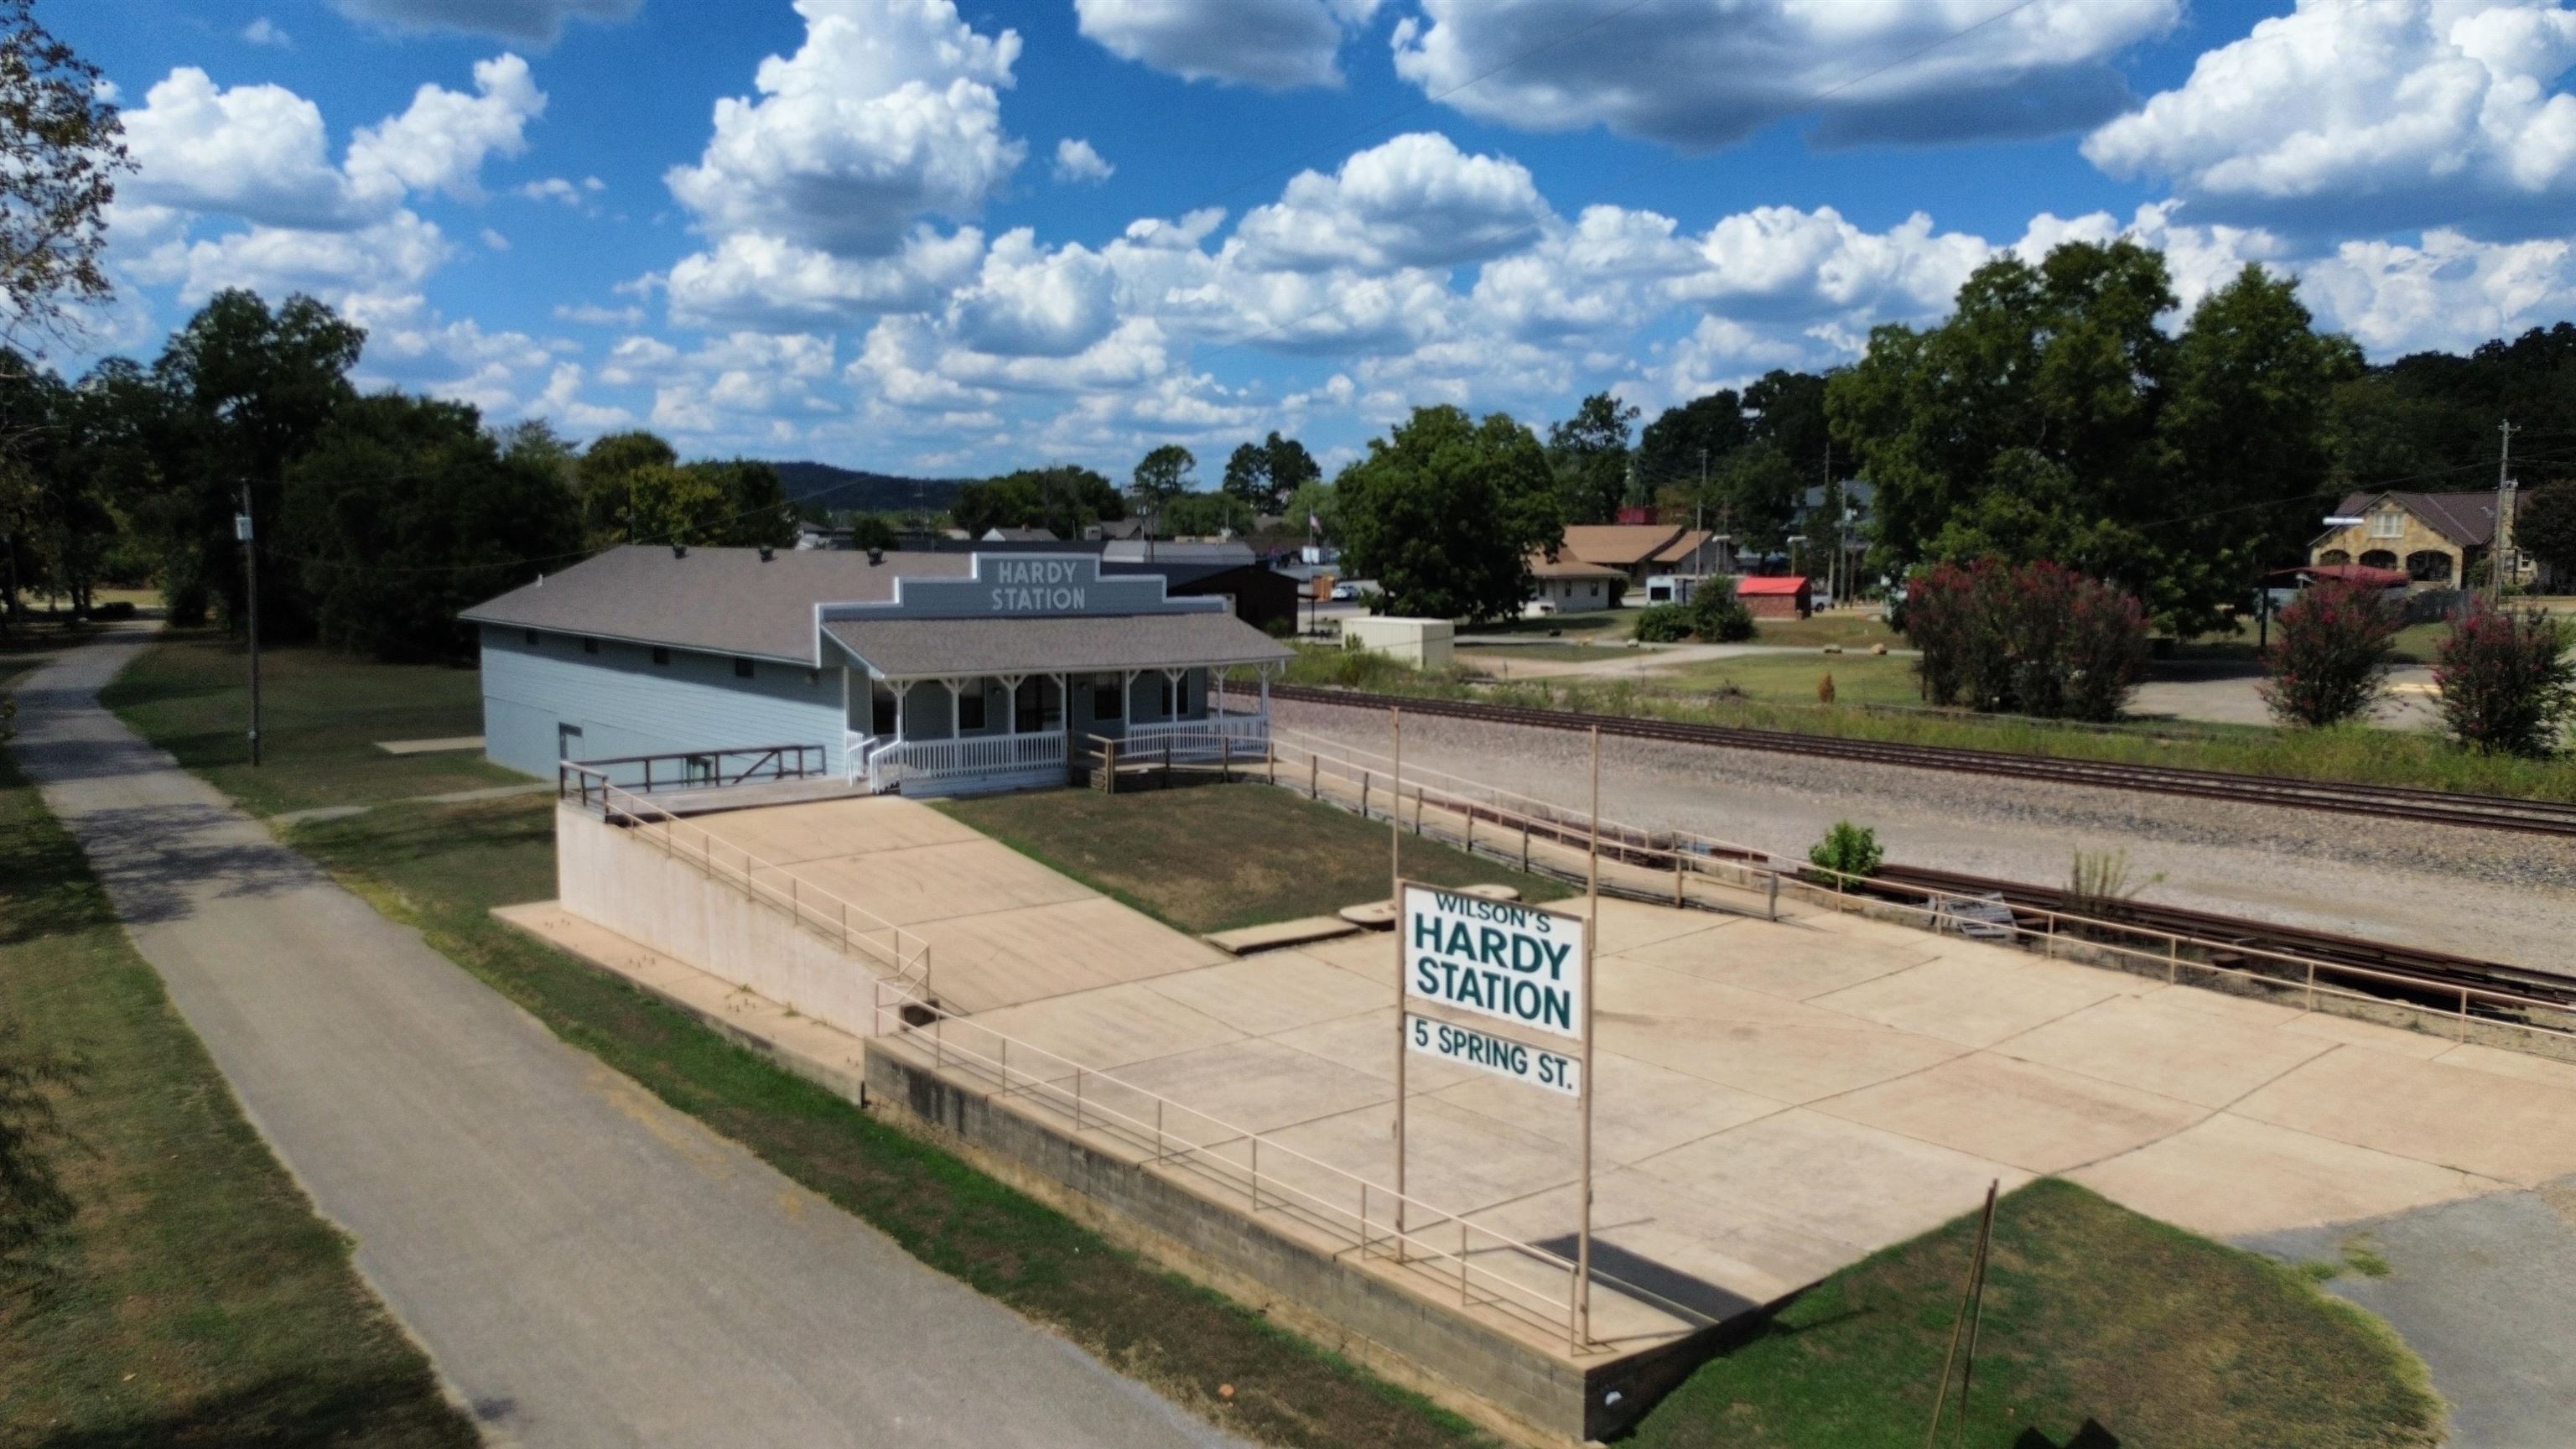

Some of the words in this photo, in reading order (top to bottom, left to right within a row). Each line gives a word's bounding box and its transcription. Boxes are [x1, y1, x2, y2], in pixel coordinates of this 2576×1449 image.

[992, 588, 1085, 610] STATION
[999, 561, 1077, 584] HARDY
[1436, 893, 1550, 932] WILSON'S
[1415, 912, 1571, 980] HARDY
[1417, 956, 1571, 1030] STATION
[1415, 1020, 1429, 1046] 5
[1438, 1026, 1528, 1075] SPRING
[1539, 1053, 1572, 1089] ST.
